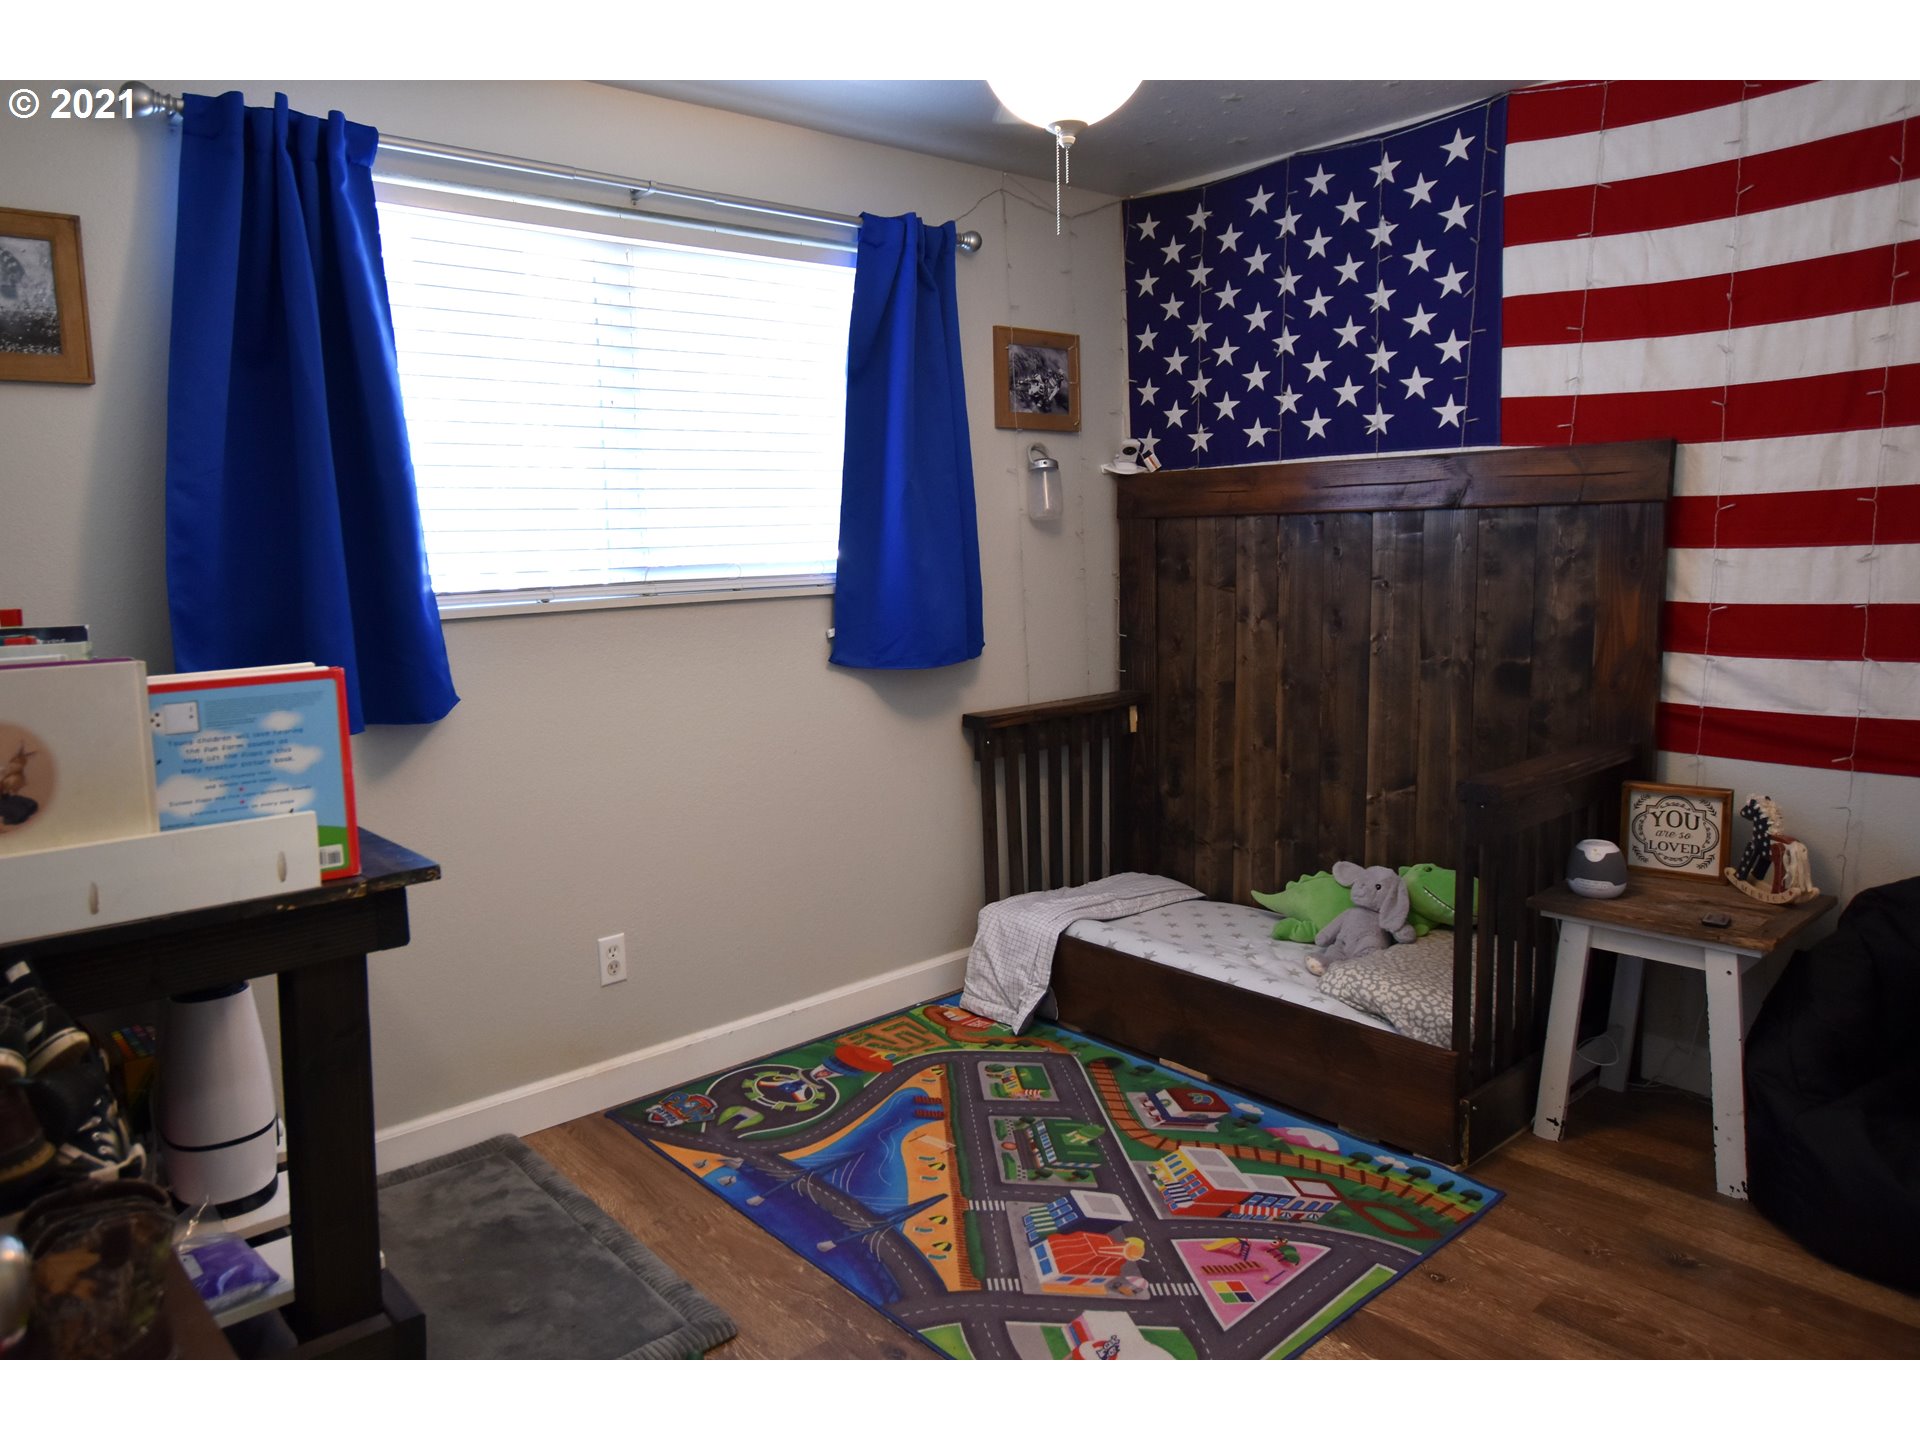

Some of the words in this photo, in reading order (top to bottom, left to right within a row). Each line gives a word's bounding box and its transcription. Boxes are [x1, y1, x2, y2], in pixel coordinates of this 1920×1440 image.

[1651, 810, 1700, 831] YOU
[1655, 830, 1676, 838] are
[1678, 832, 1691, 840] so
[1649, 840, 1700, 855] LOVED
